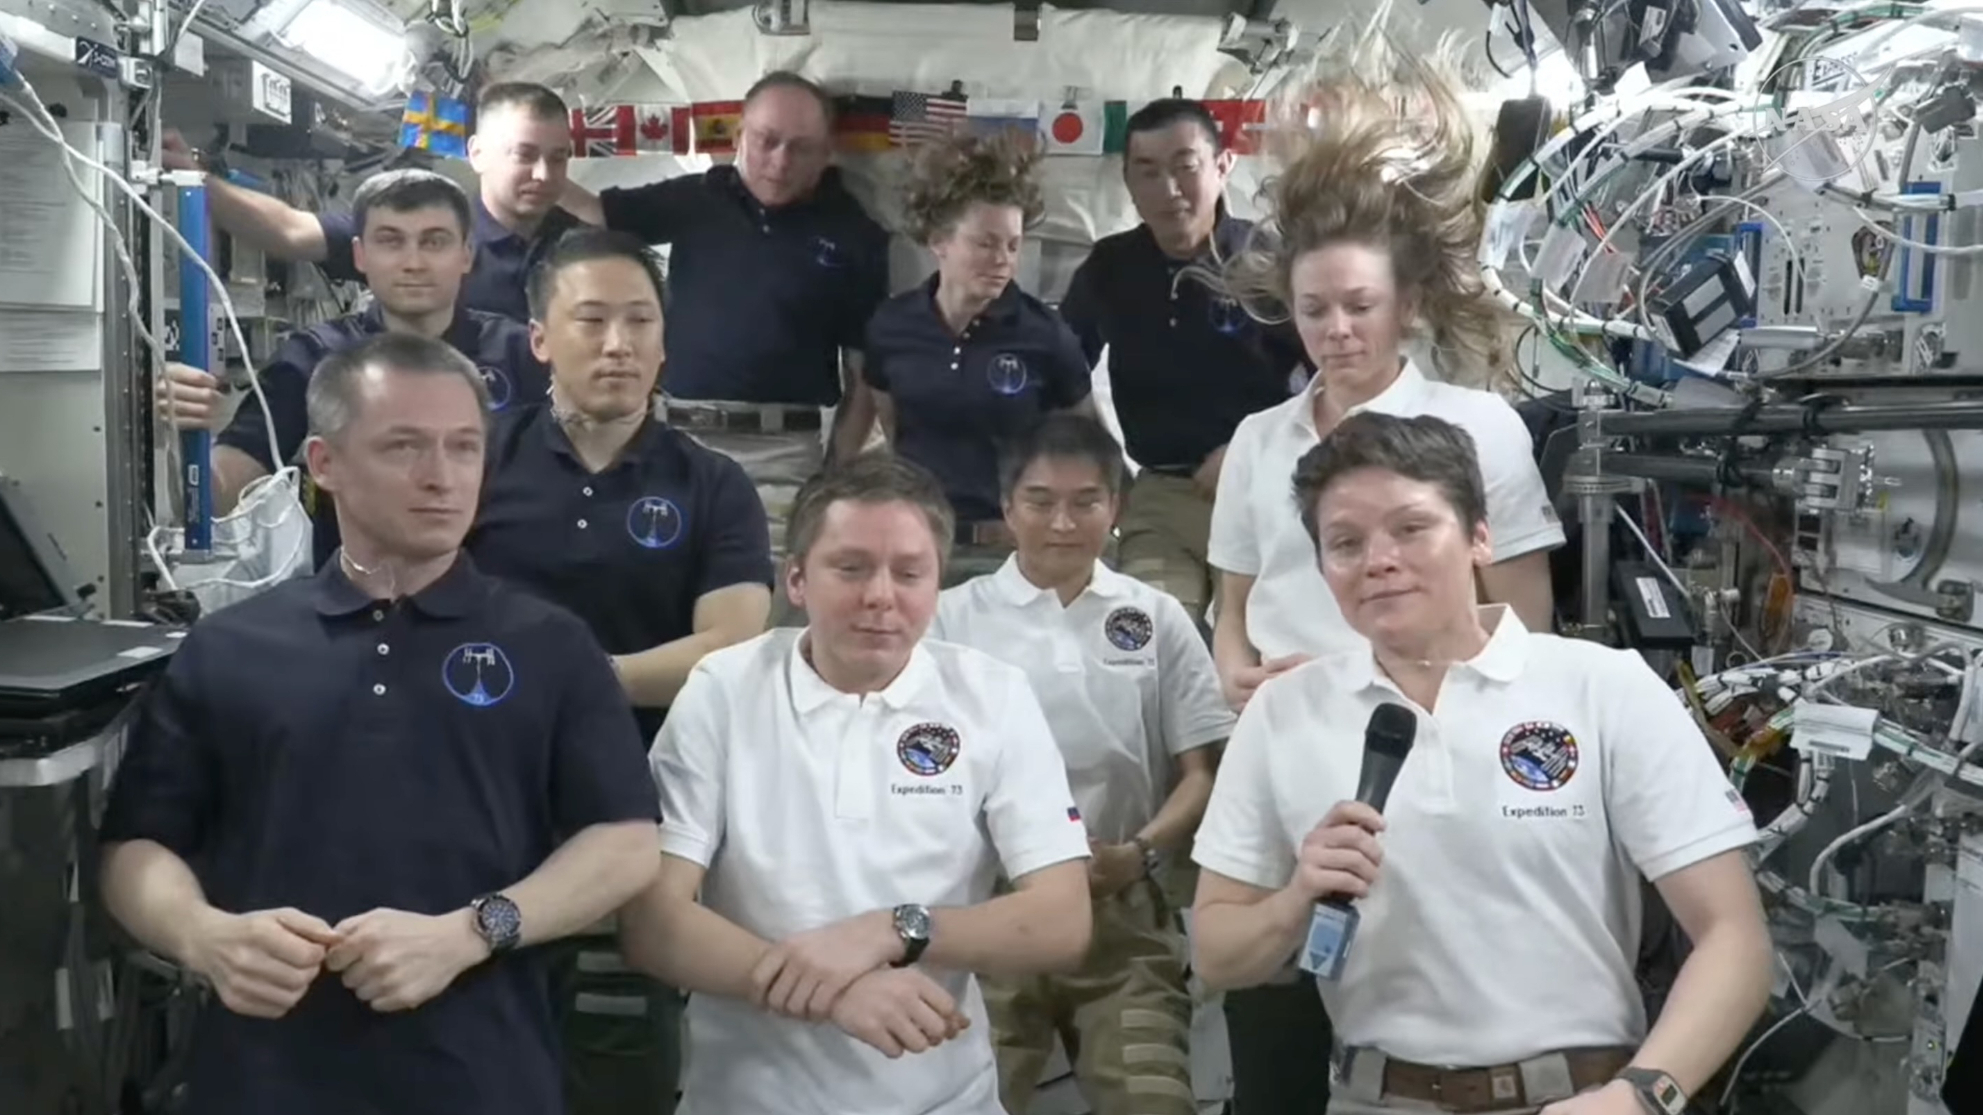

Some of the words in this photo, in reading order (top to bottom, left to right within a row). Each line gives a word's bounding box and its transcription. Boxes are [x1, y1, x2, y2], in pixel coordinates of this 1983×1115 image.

[891, 784, 945, 796] Expedition
[951, 785, 963, 795] 73
[1502, 805, 1567, 818] Expedition
[1573, 805, 1585, 817] 73
